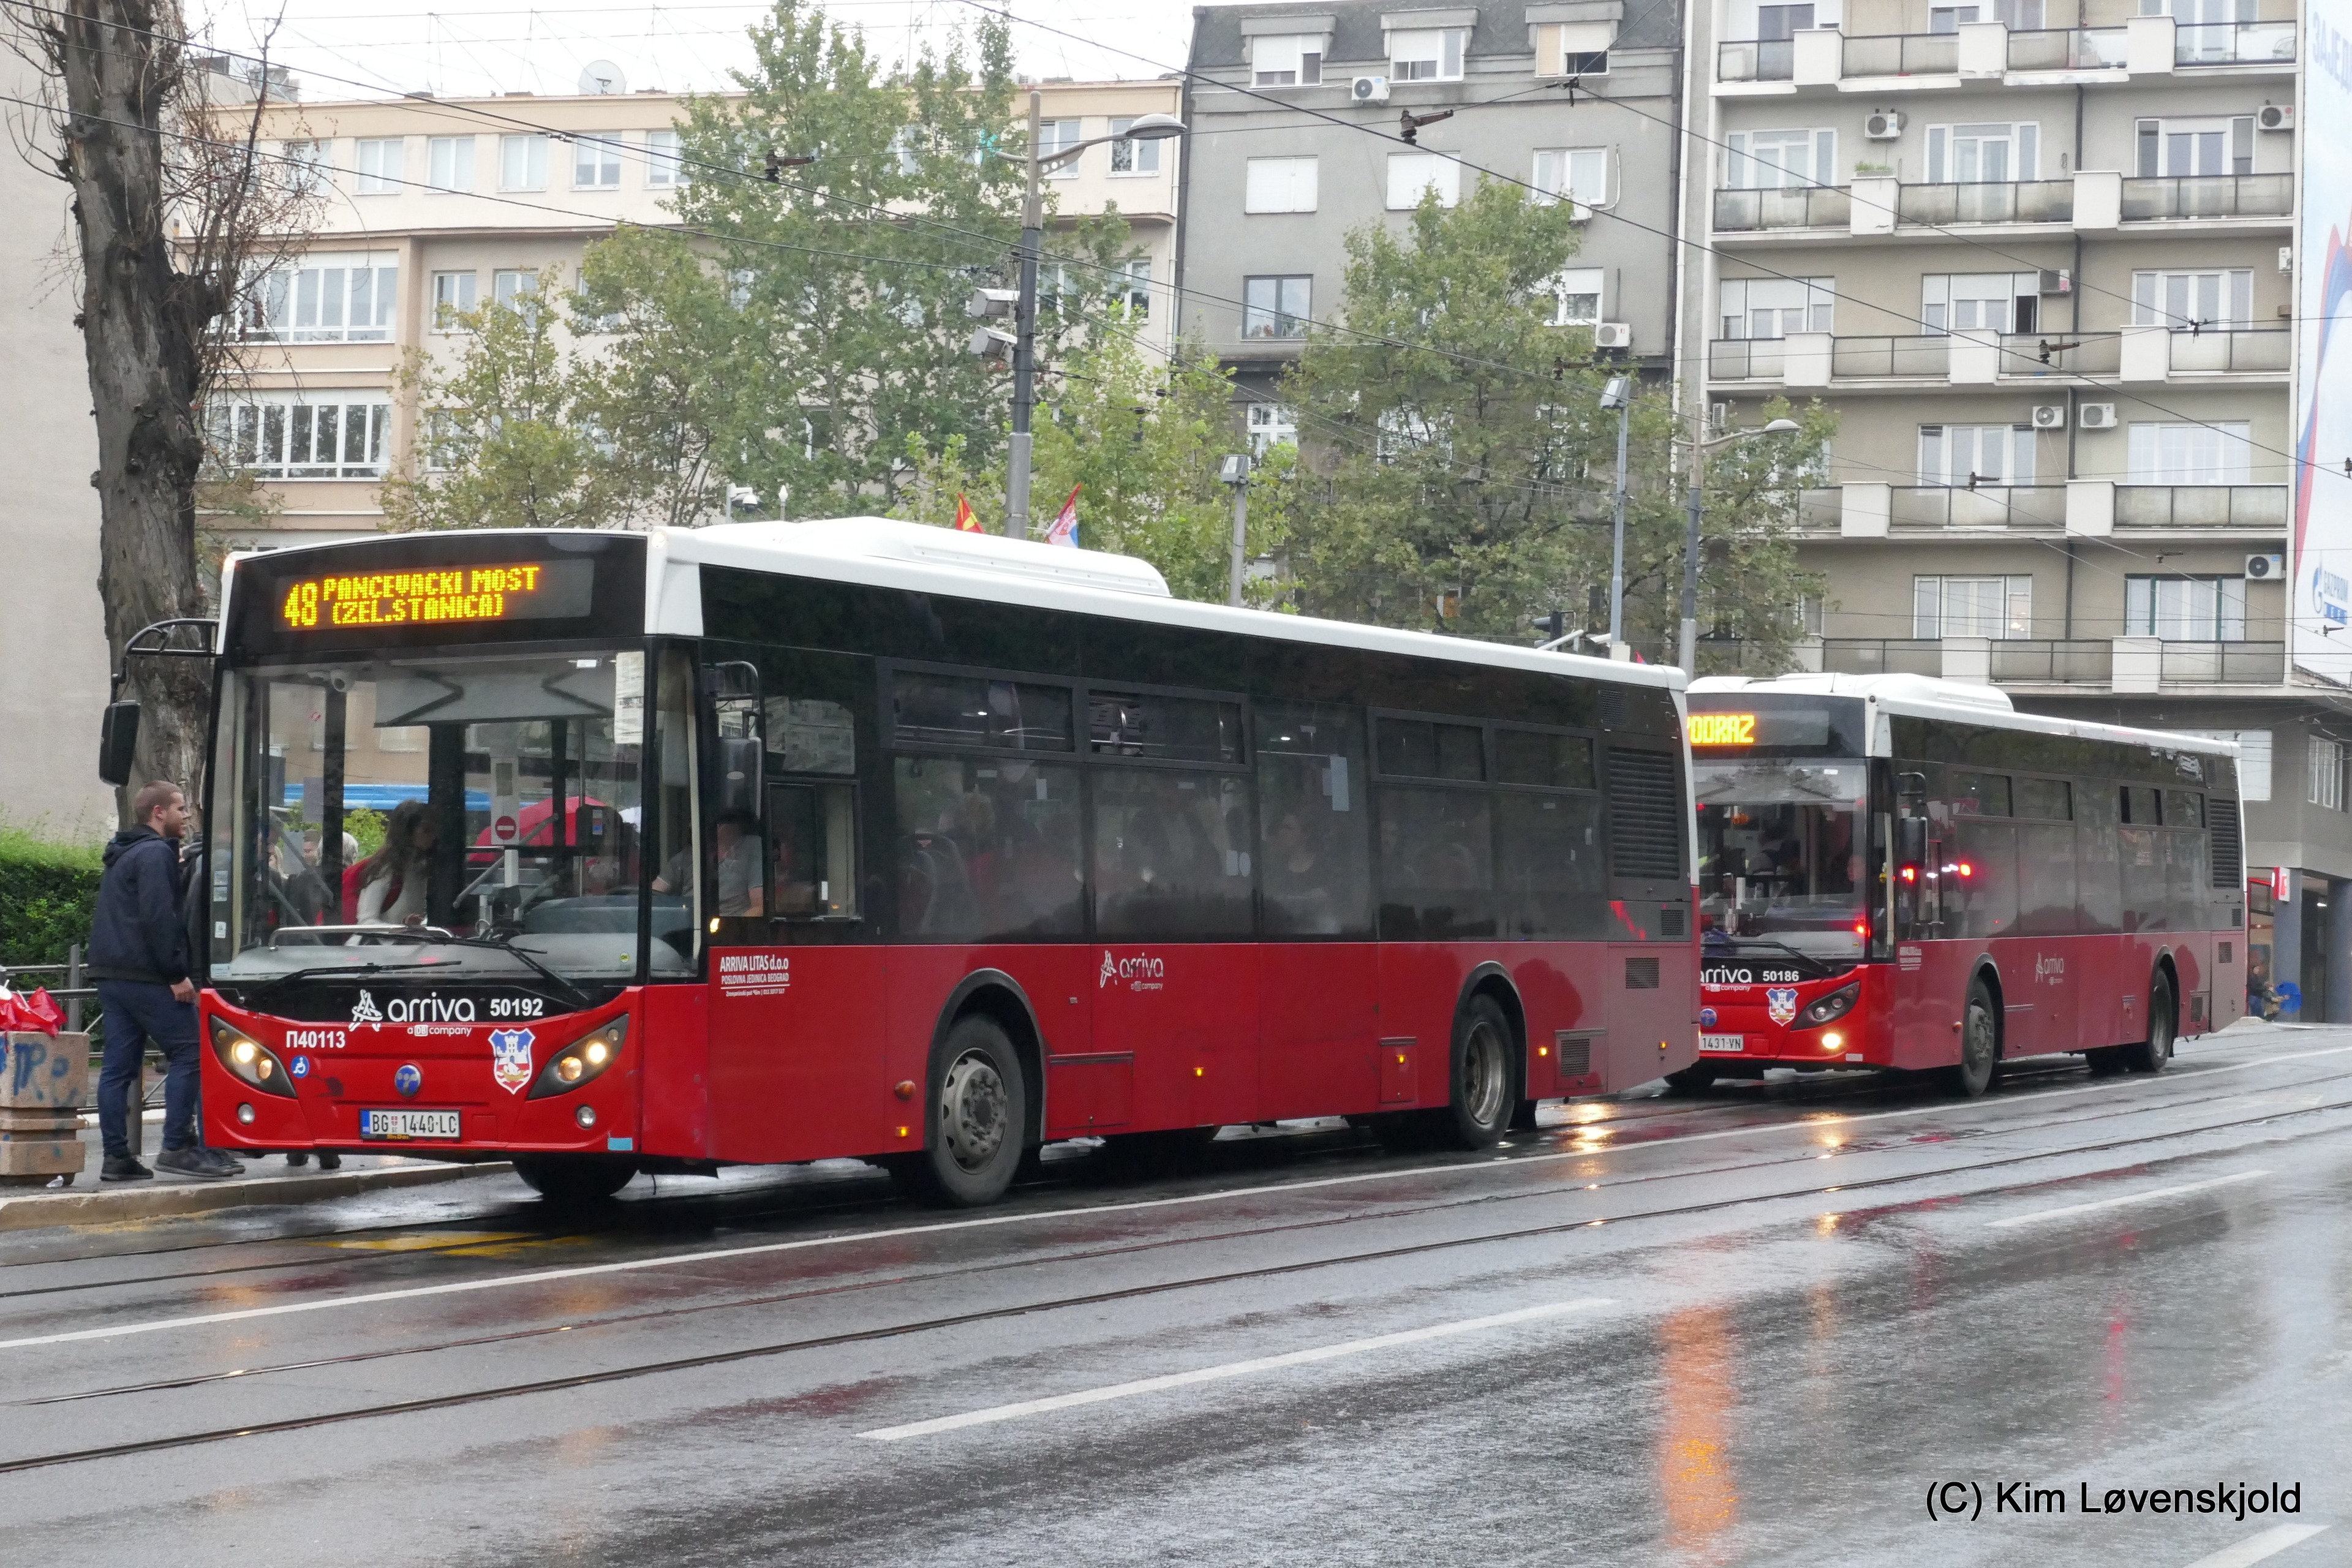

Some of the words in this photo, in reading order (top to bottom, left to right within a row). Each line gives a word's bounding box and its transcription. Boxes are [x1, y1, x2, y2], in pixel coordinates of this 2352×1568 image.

[284, 582, 318, 627] 48
[323, 571, 463, 601] PANCEVACKI
[472, 566, 540, 591] MOST
[720, 956, 748, 972] ARRIVA
[749, 955, 769, 971] LITAS
[769, 954, 789, 970] d.o.o
[1120, 952, 1164, 978] arriva
[722, 975, 746, 984] POSLOVNA
[767, 973, 789, 982] BEOGRAD
[1763, 971, 1800, 982] 50186
[387, 992, 475, 1022] arriva
[490, 998, 543, 1017] 50192
[429, 1026, 472, 1036] company
[1703, 1038, 1741, 1049] 1431-VN
[372, 1114, 388, 1133] BG
